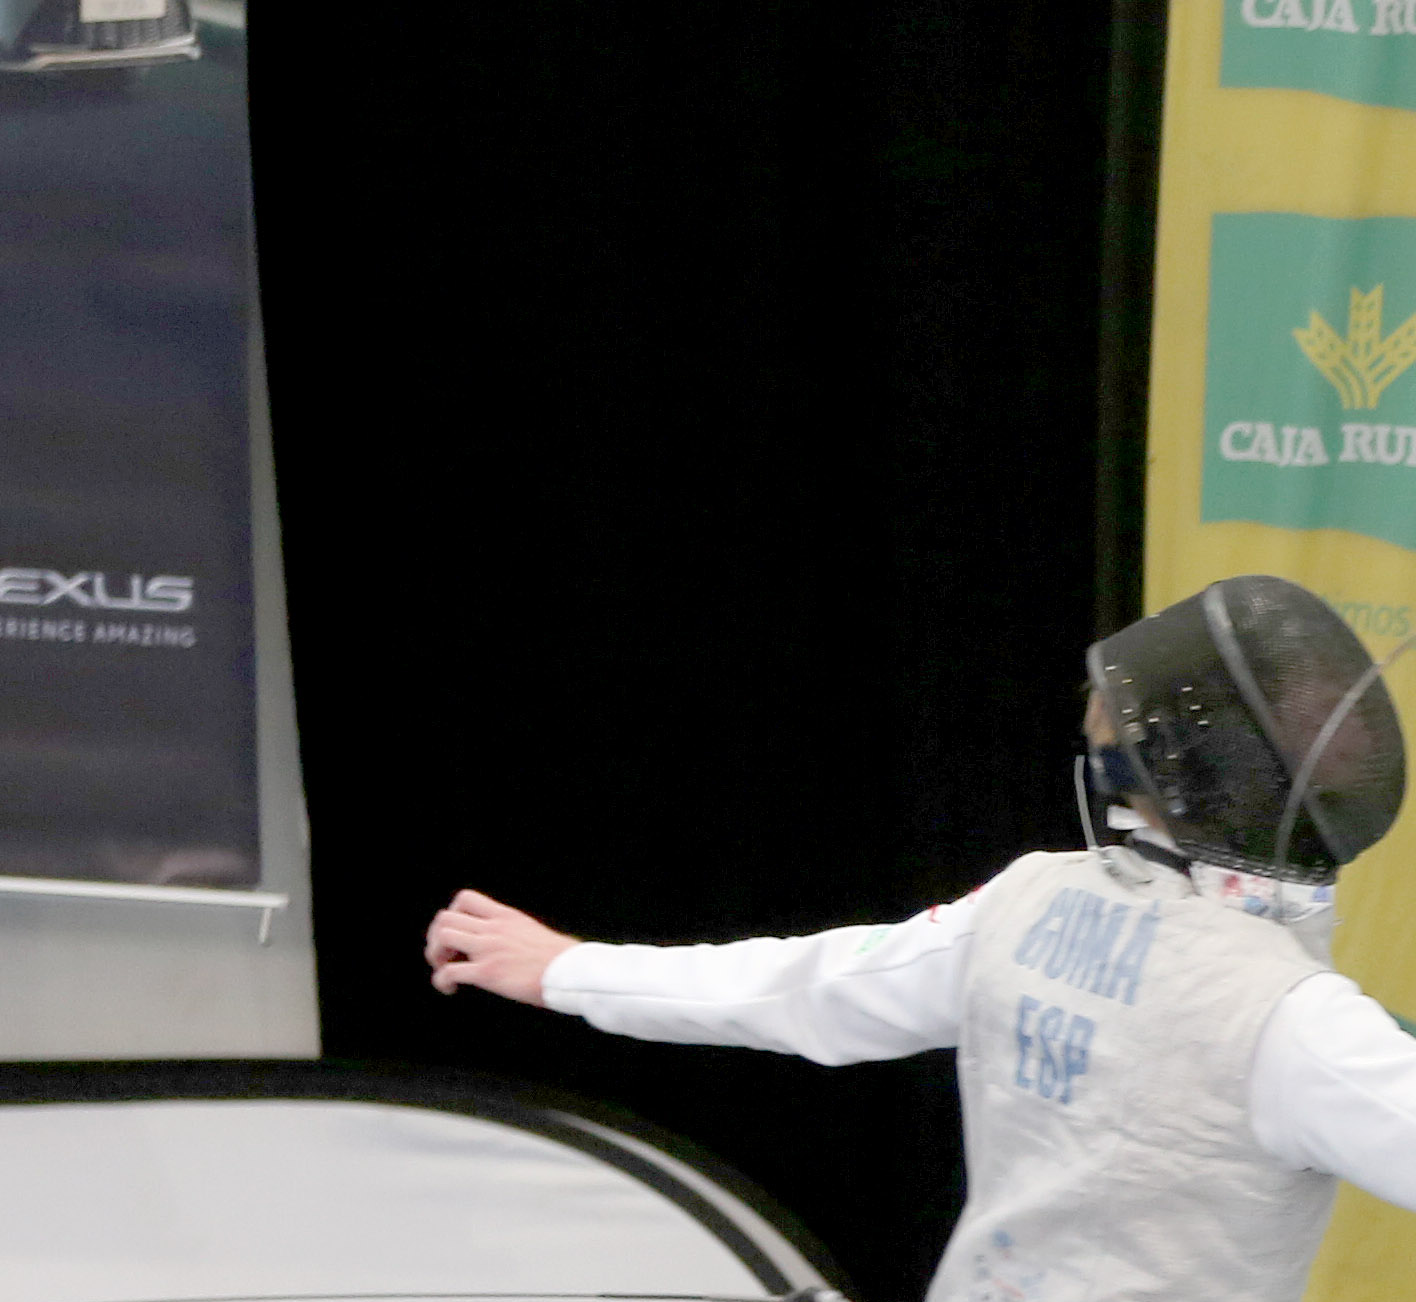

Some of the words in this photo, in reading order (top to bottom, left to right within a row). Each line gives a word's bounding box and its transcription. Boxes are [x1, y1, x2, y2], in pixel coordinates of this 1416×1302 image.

[1219, 420, 1328, 467] CAJA
[0, 619, 86, 643] RIENCE
[92, 621, 198, 649] AMAZING
[1015, 993, 1097, 1105] ESP
